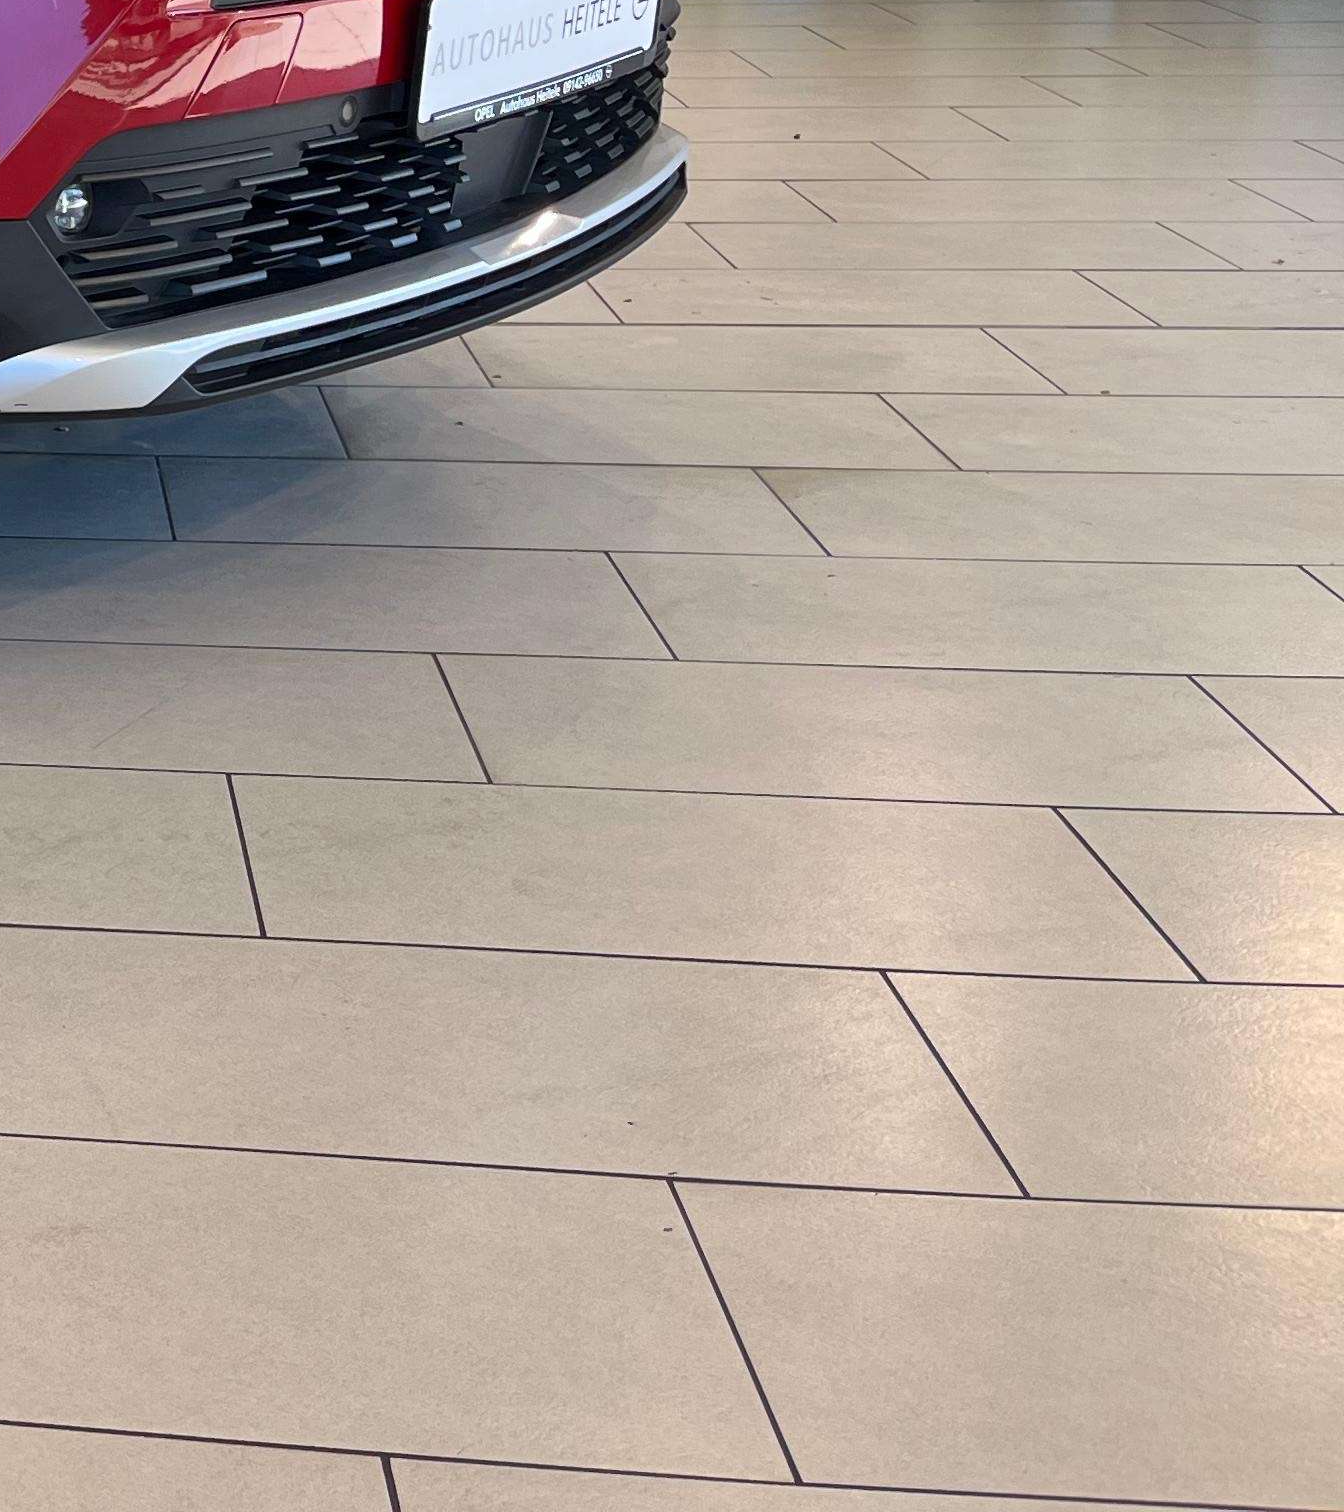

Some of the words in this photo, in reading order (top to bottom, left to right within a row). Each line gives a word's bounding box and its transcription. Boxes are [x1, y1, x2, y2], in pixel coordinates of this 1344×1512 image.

[430, 12, 555, 76] AUTOHAUS
[474, 104, 495, 122] OPEL
[499, 94, 536, 115] Autohaus
